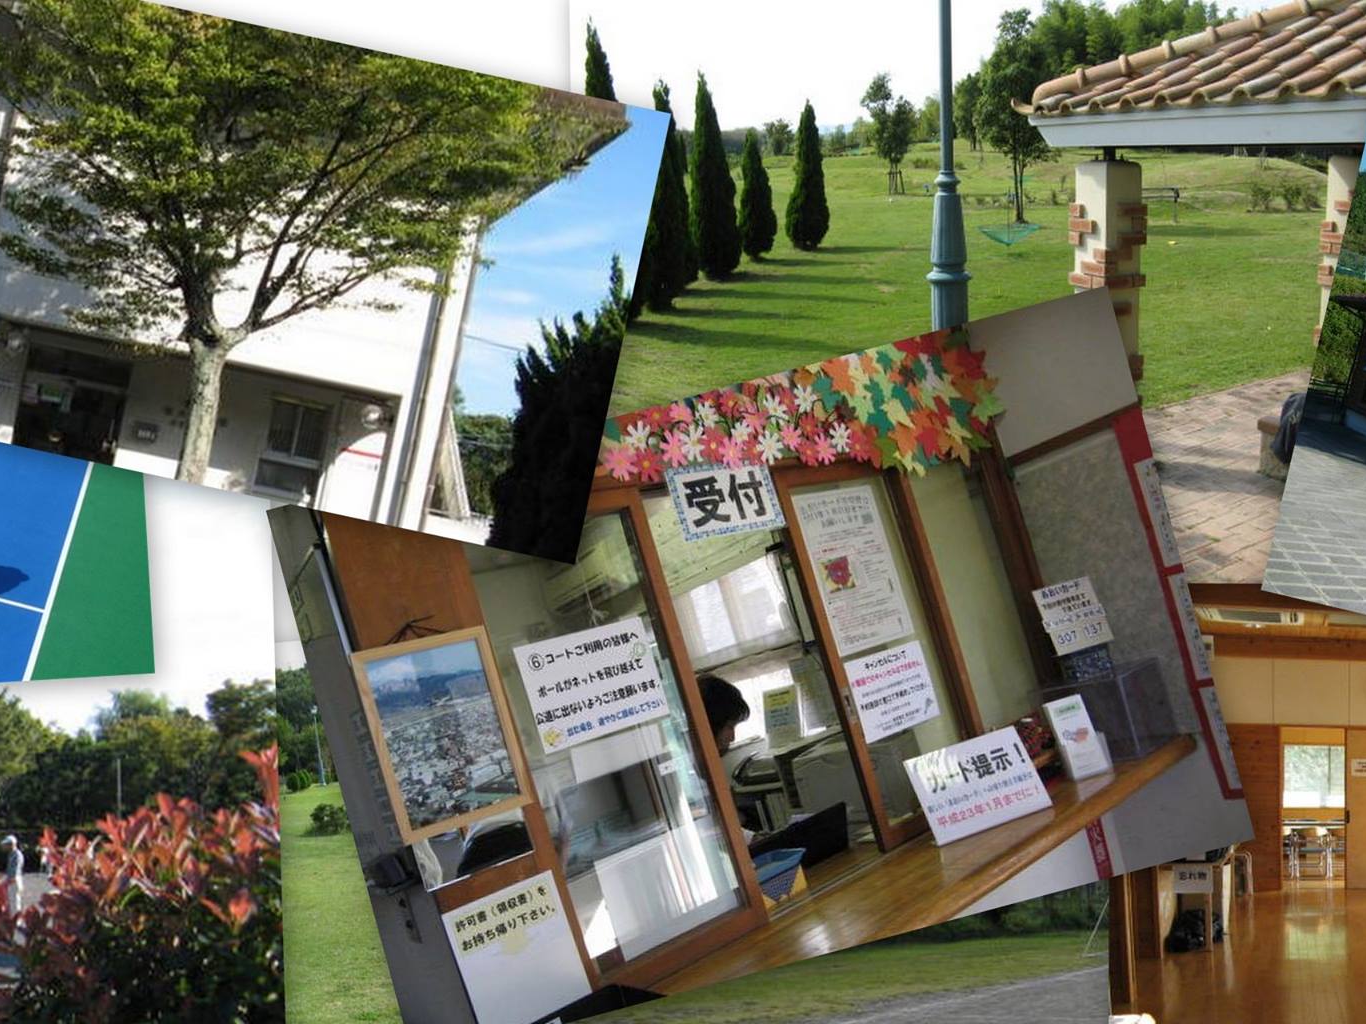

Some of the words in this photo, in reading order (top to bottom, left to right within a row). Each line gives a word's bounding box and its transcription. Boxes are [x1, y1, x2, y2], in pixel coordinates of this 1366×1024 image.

[681, 470, 767, 528] 受付
[1057, 630, 1077, 645] 307
[1084, 622, 1103, 638] 137
[1178, 871, 1208, 881] 忘れ物
[455, 885, 547, 932] 許可書（領収書）を
[462, 904, 555, 951] お持ち帰り下さい。
